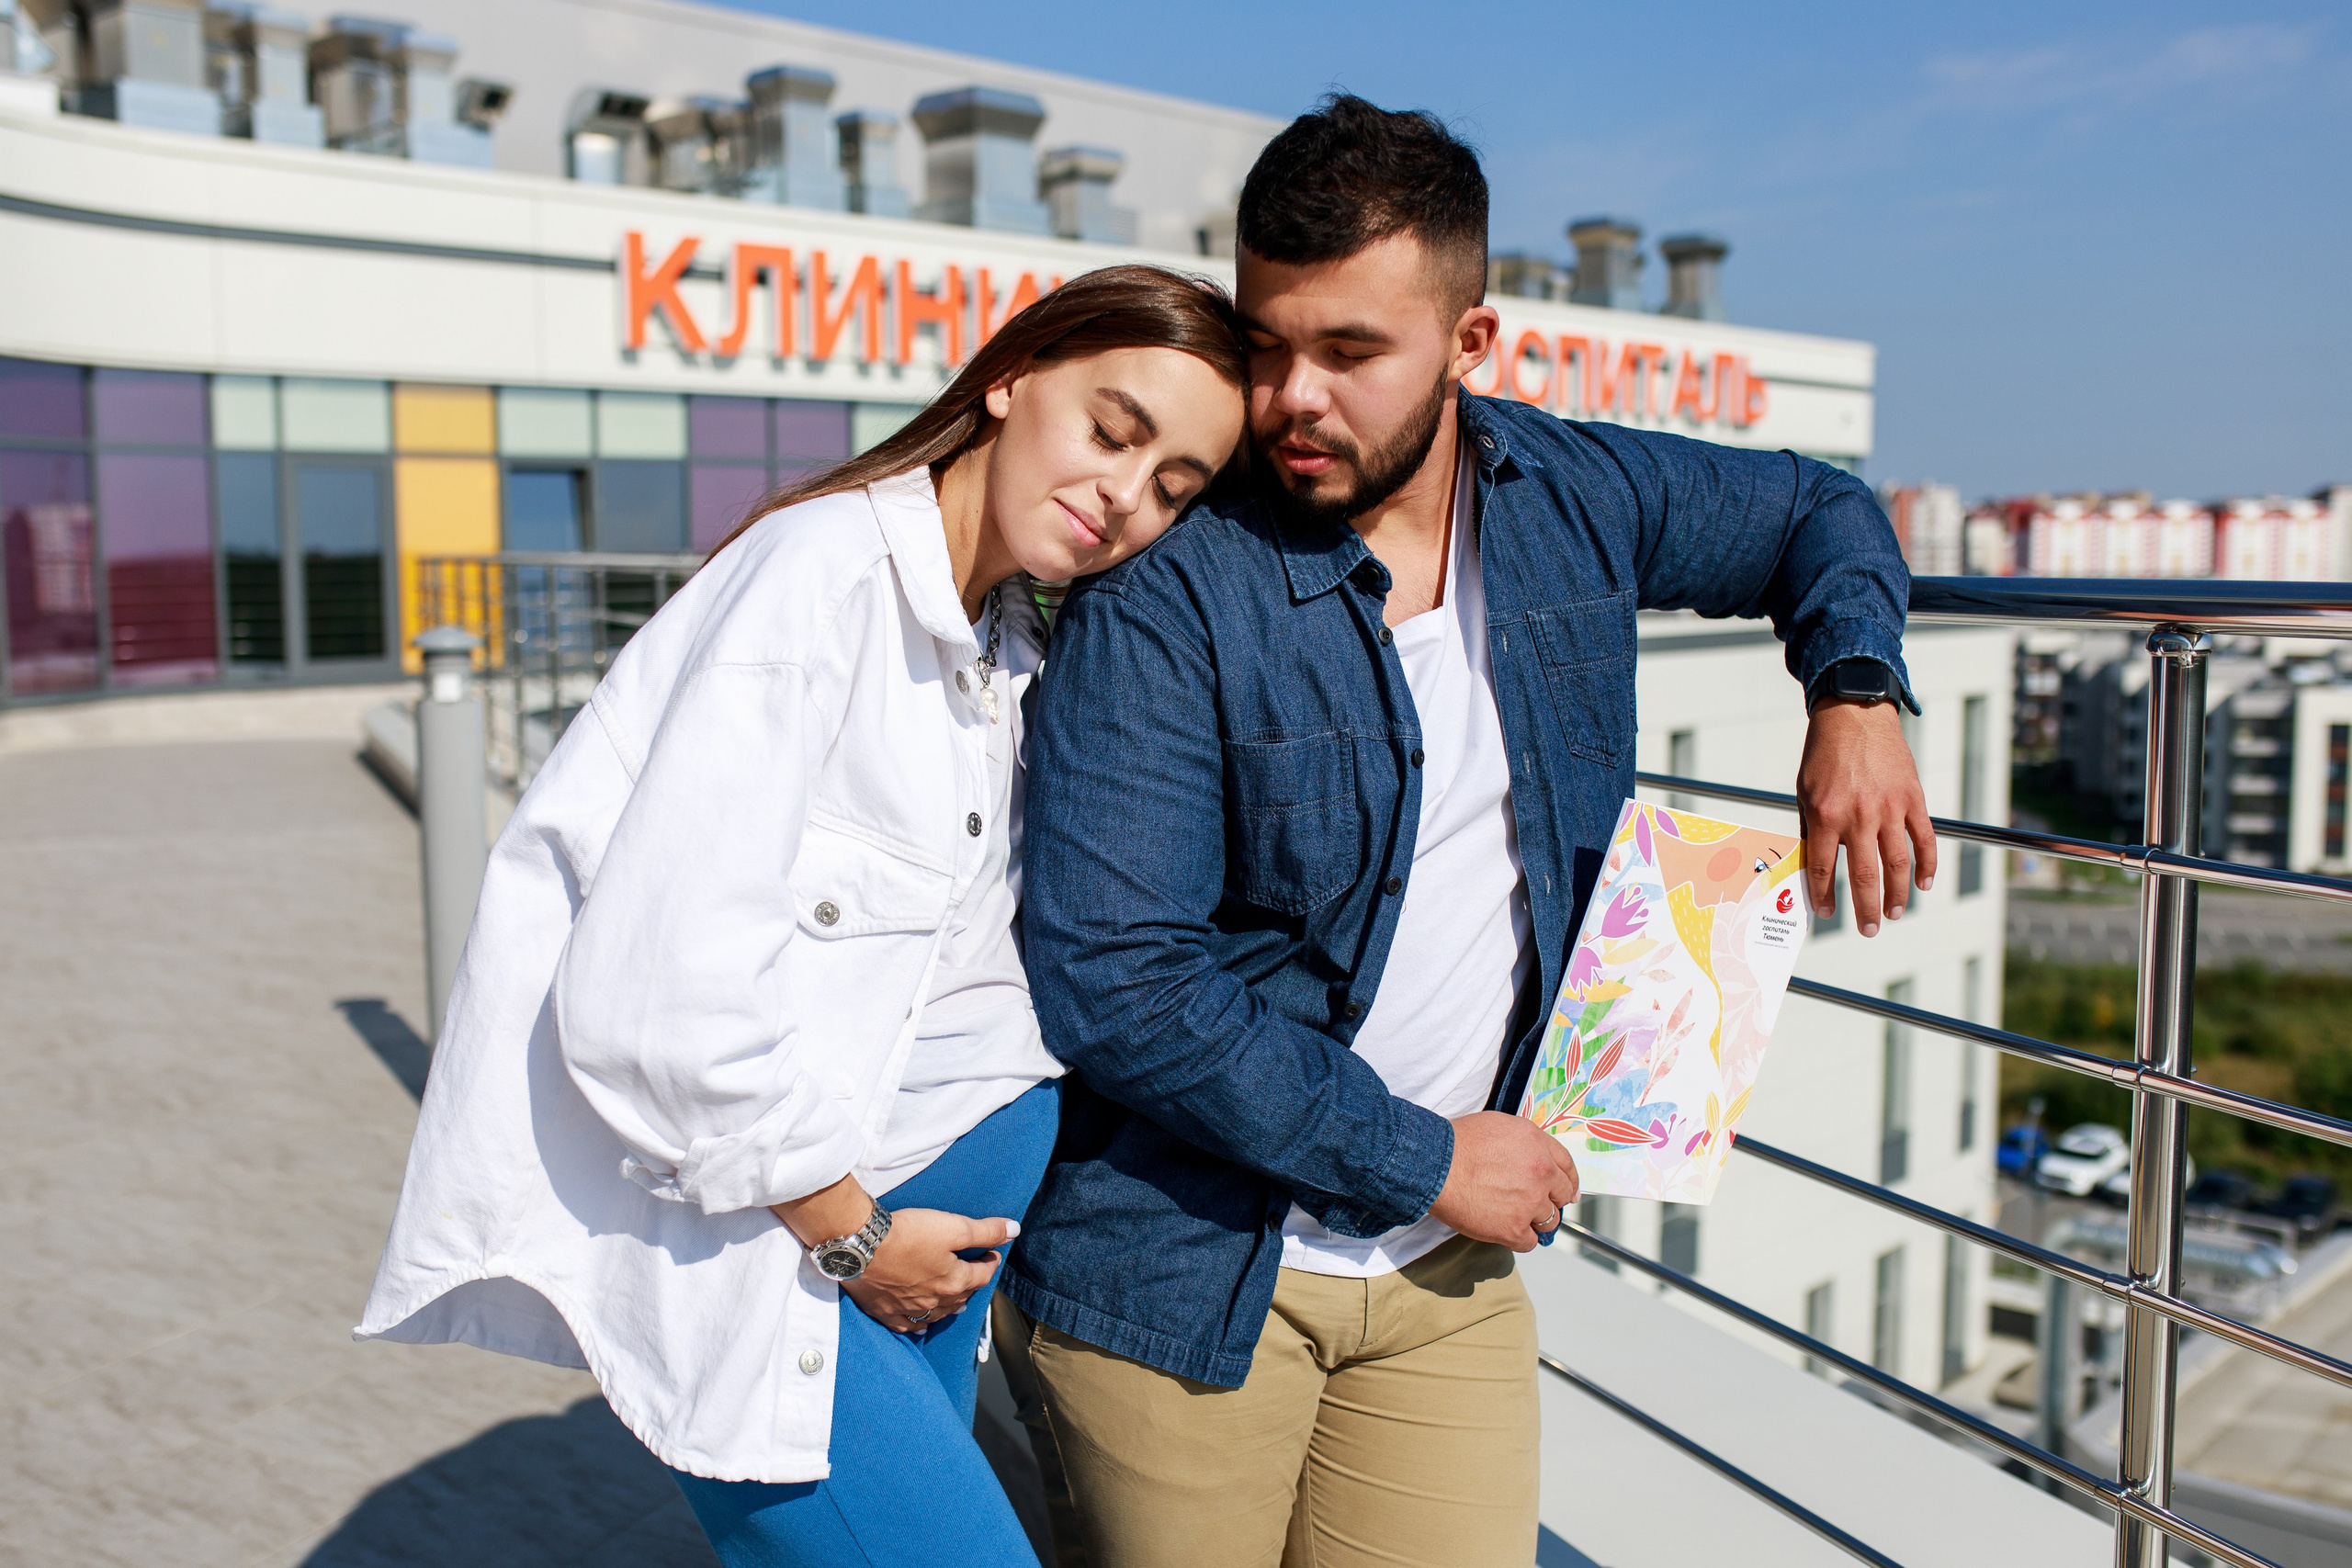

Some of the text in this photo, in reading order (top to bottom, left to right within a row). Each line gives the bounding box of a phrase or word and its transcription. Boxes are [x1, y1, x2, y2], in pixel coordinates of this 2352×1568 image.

[622, 230, 1064, 368] КЛИНИ
[1761, 915, 1797, 928] Клинический
[1762, 925, 1790, 935] госпиталь
[1763, 932, 1784, 942] Тюмень
